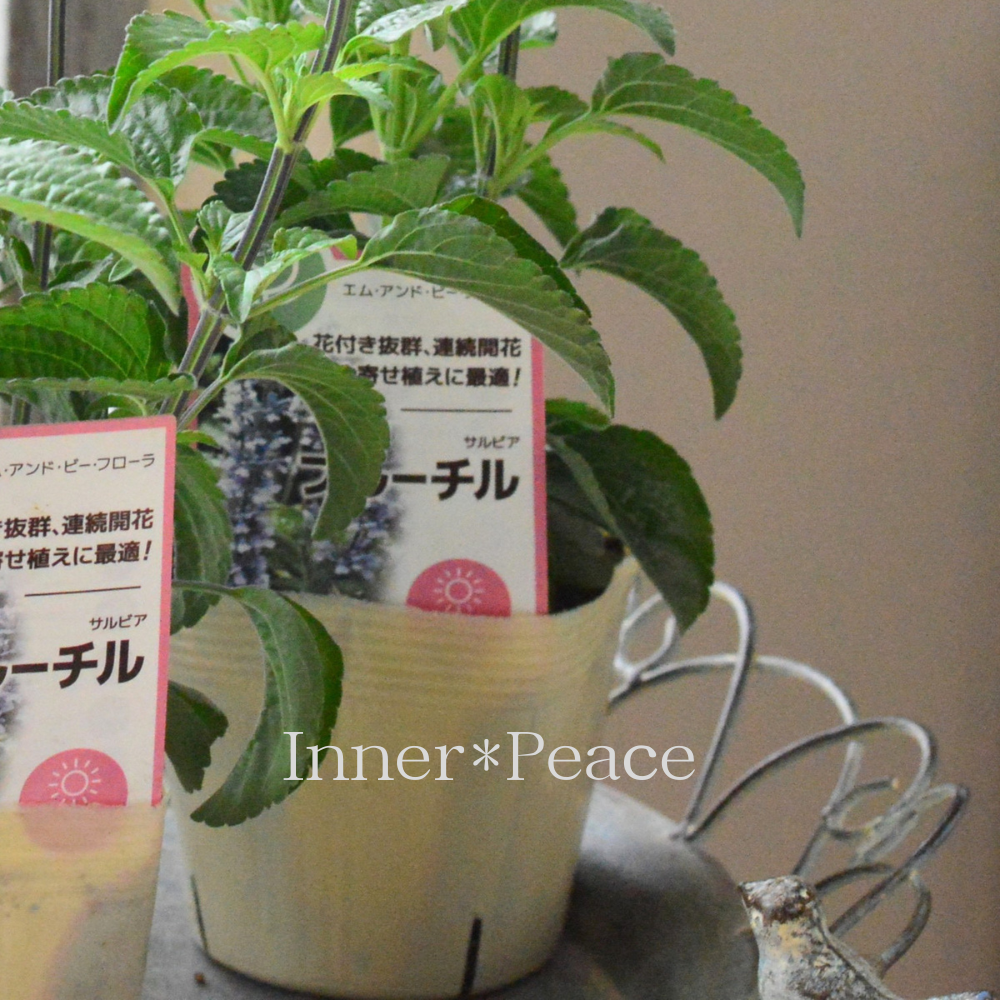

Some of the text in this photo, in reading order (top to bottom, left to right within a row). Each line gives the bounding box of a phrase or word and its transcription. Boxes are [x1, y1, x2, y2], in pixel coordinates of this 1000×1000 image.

[313, 333, 521, 357] 花付き抜群、連続開花
[354, 364, 521, 387] 寄せ植えに最適!
[464, 435, 520, 449] サルビア
[89, 614, 147, 630] サルビア
